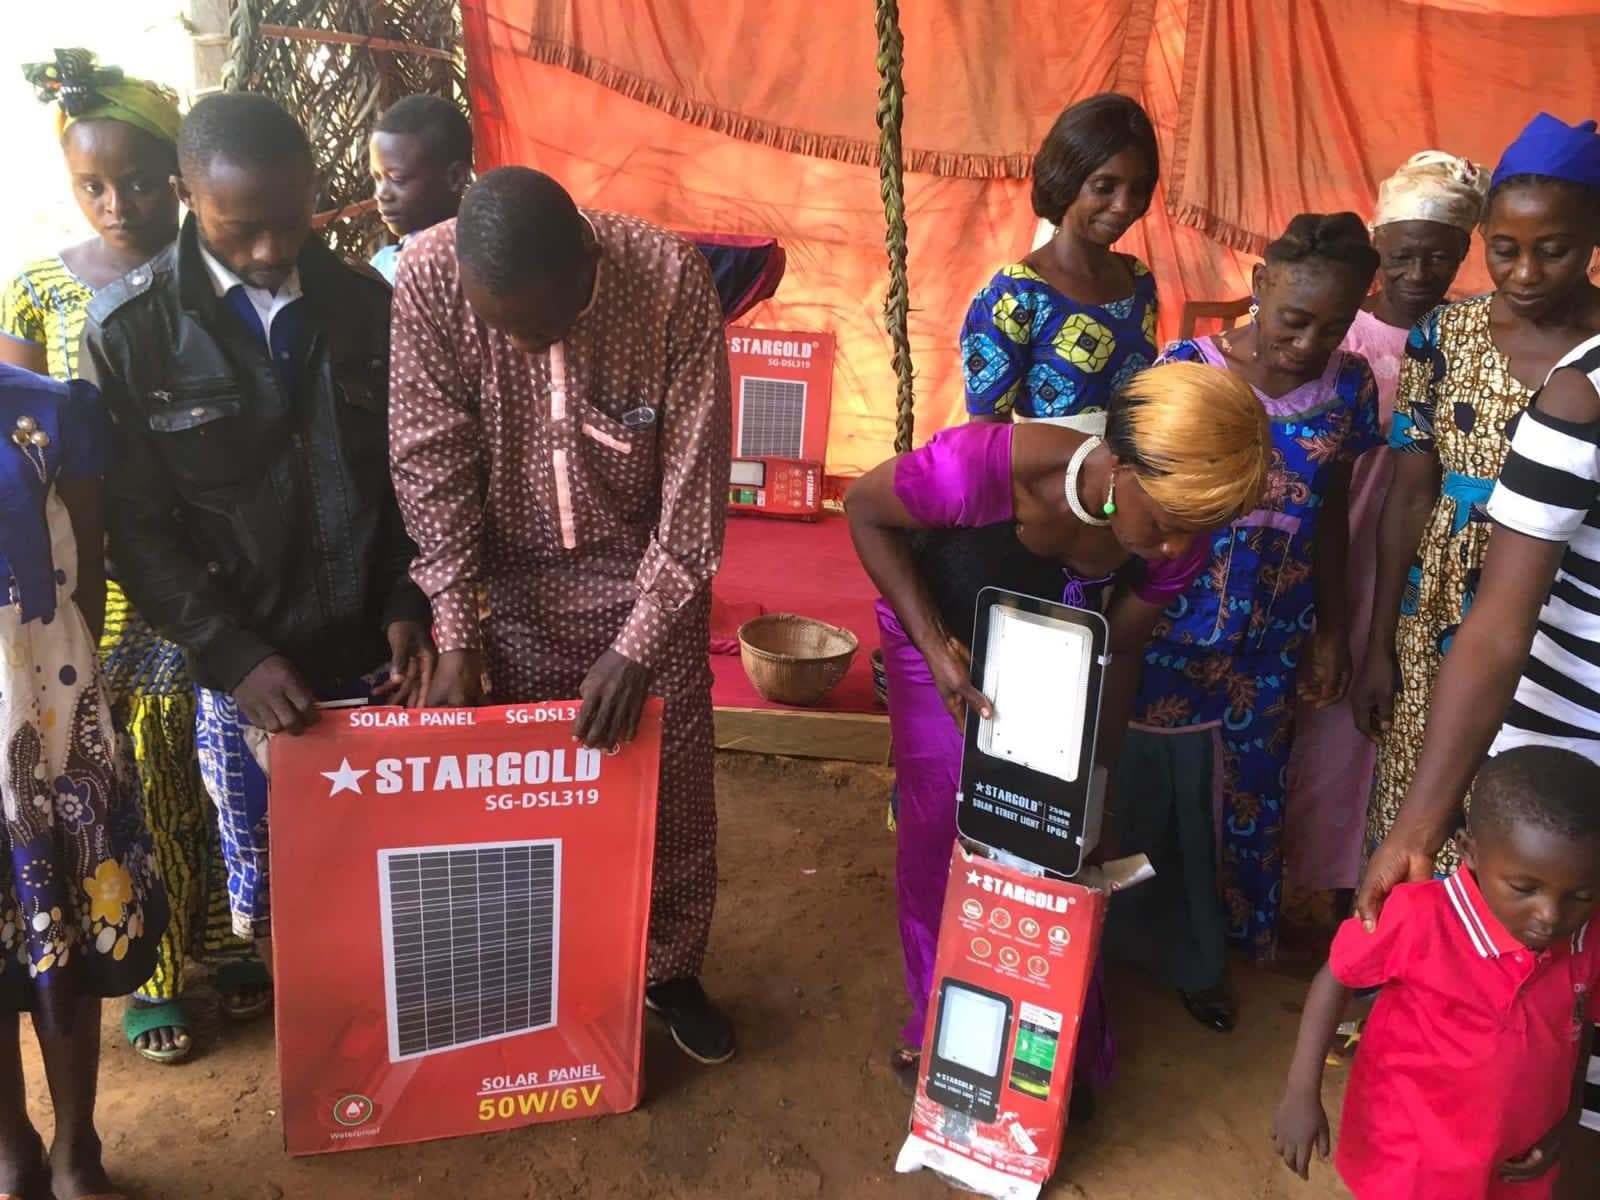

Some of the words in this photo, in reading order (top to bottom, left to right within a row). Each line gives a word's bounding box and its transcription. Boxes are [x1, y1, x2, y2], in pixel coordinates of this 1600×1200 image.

[731, 337, 812, 359] STARGOLD
[349, 711, 410, 728] SOLAR
[420, 711, 476, 726] PANEL
[505, 706, 576, 724] SG-DSL3
[375, 747, 601, 795] STARGOLD
[485, 788, 600, 811] SG-DSL319
[985, 783, 1038, 813] STARGOLD
[972, 798, 993, 813] SOLAR
[994, 806, 1019, 822] STREET
[1020, 815, 1041, 829] LIGHT
[982, 875, 1069, 913] STARGOLD
[481, 1071, 539, 1092] SOLAR
[548, 1063, 602, 1082] PANEL
[478, 1083, 602, 1121] 50W/6V
